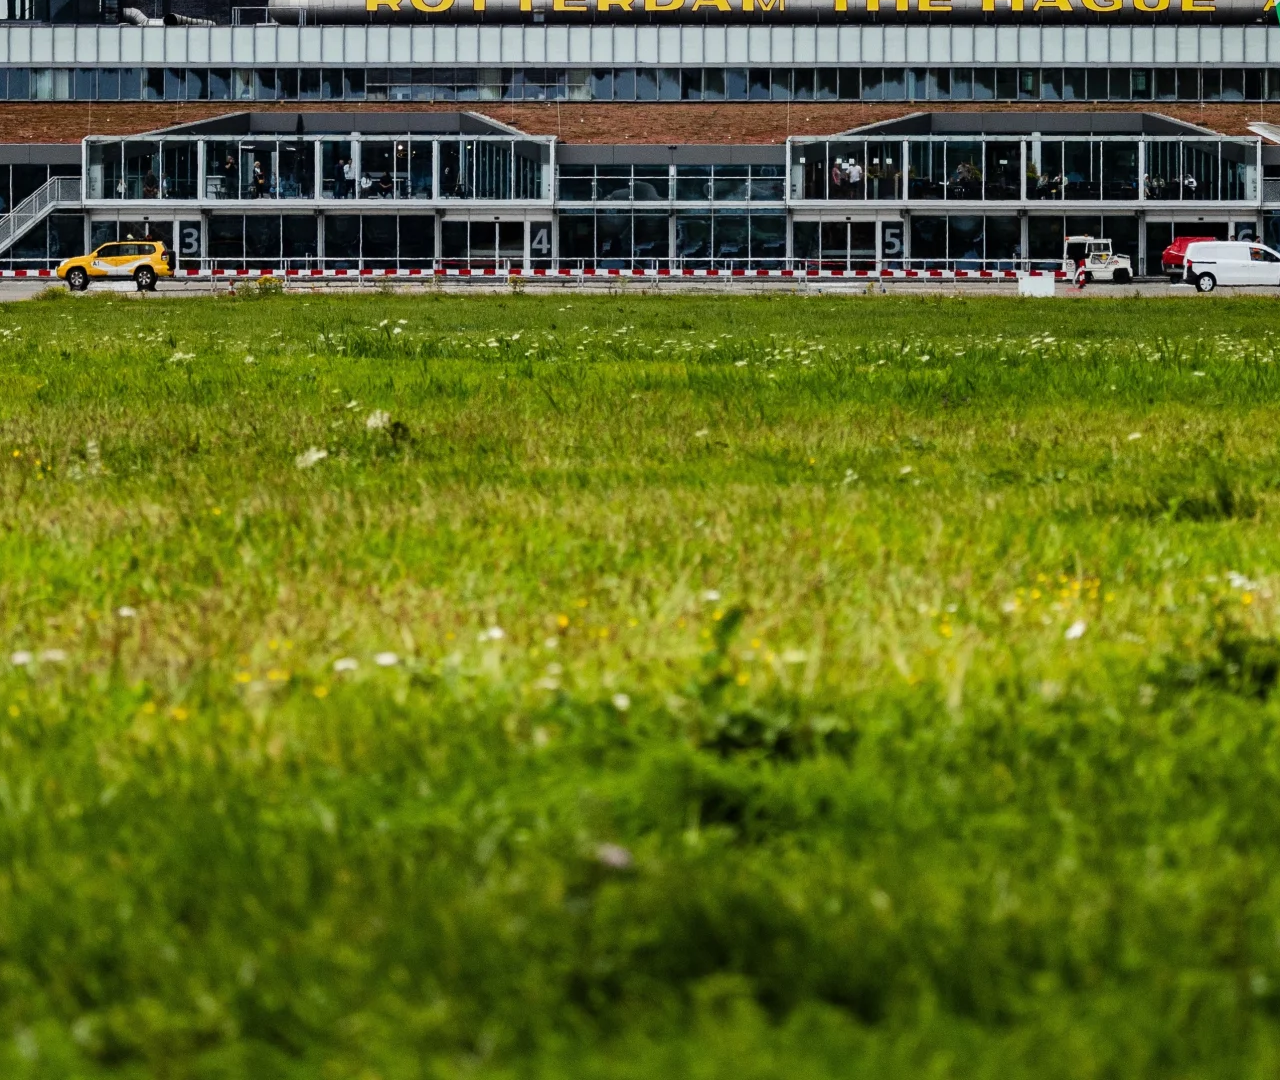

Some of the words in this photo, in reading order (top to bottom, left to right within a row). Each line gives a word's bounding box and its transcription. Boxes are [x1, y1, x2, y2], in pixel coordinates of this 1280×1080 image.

[182, 228, 198, 253] 3
[532, 228, 550, 254] 4
[885, 228, 900, 254] 5
